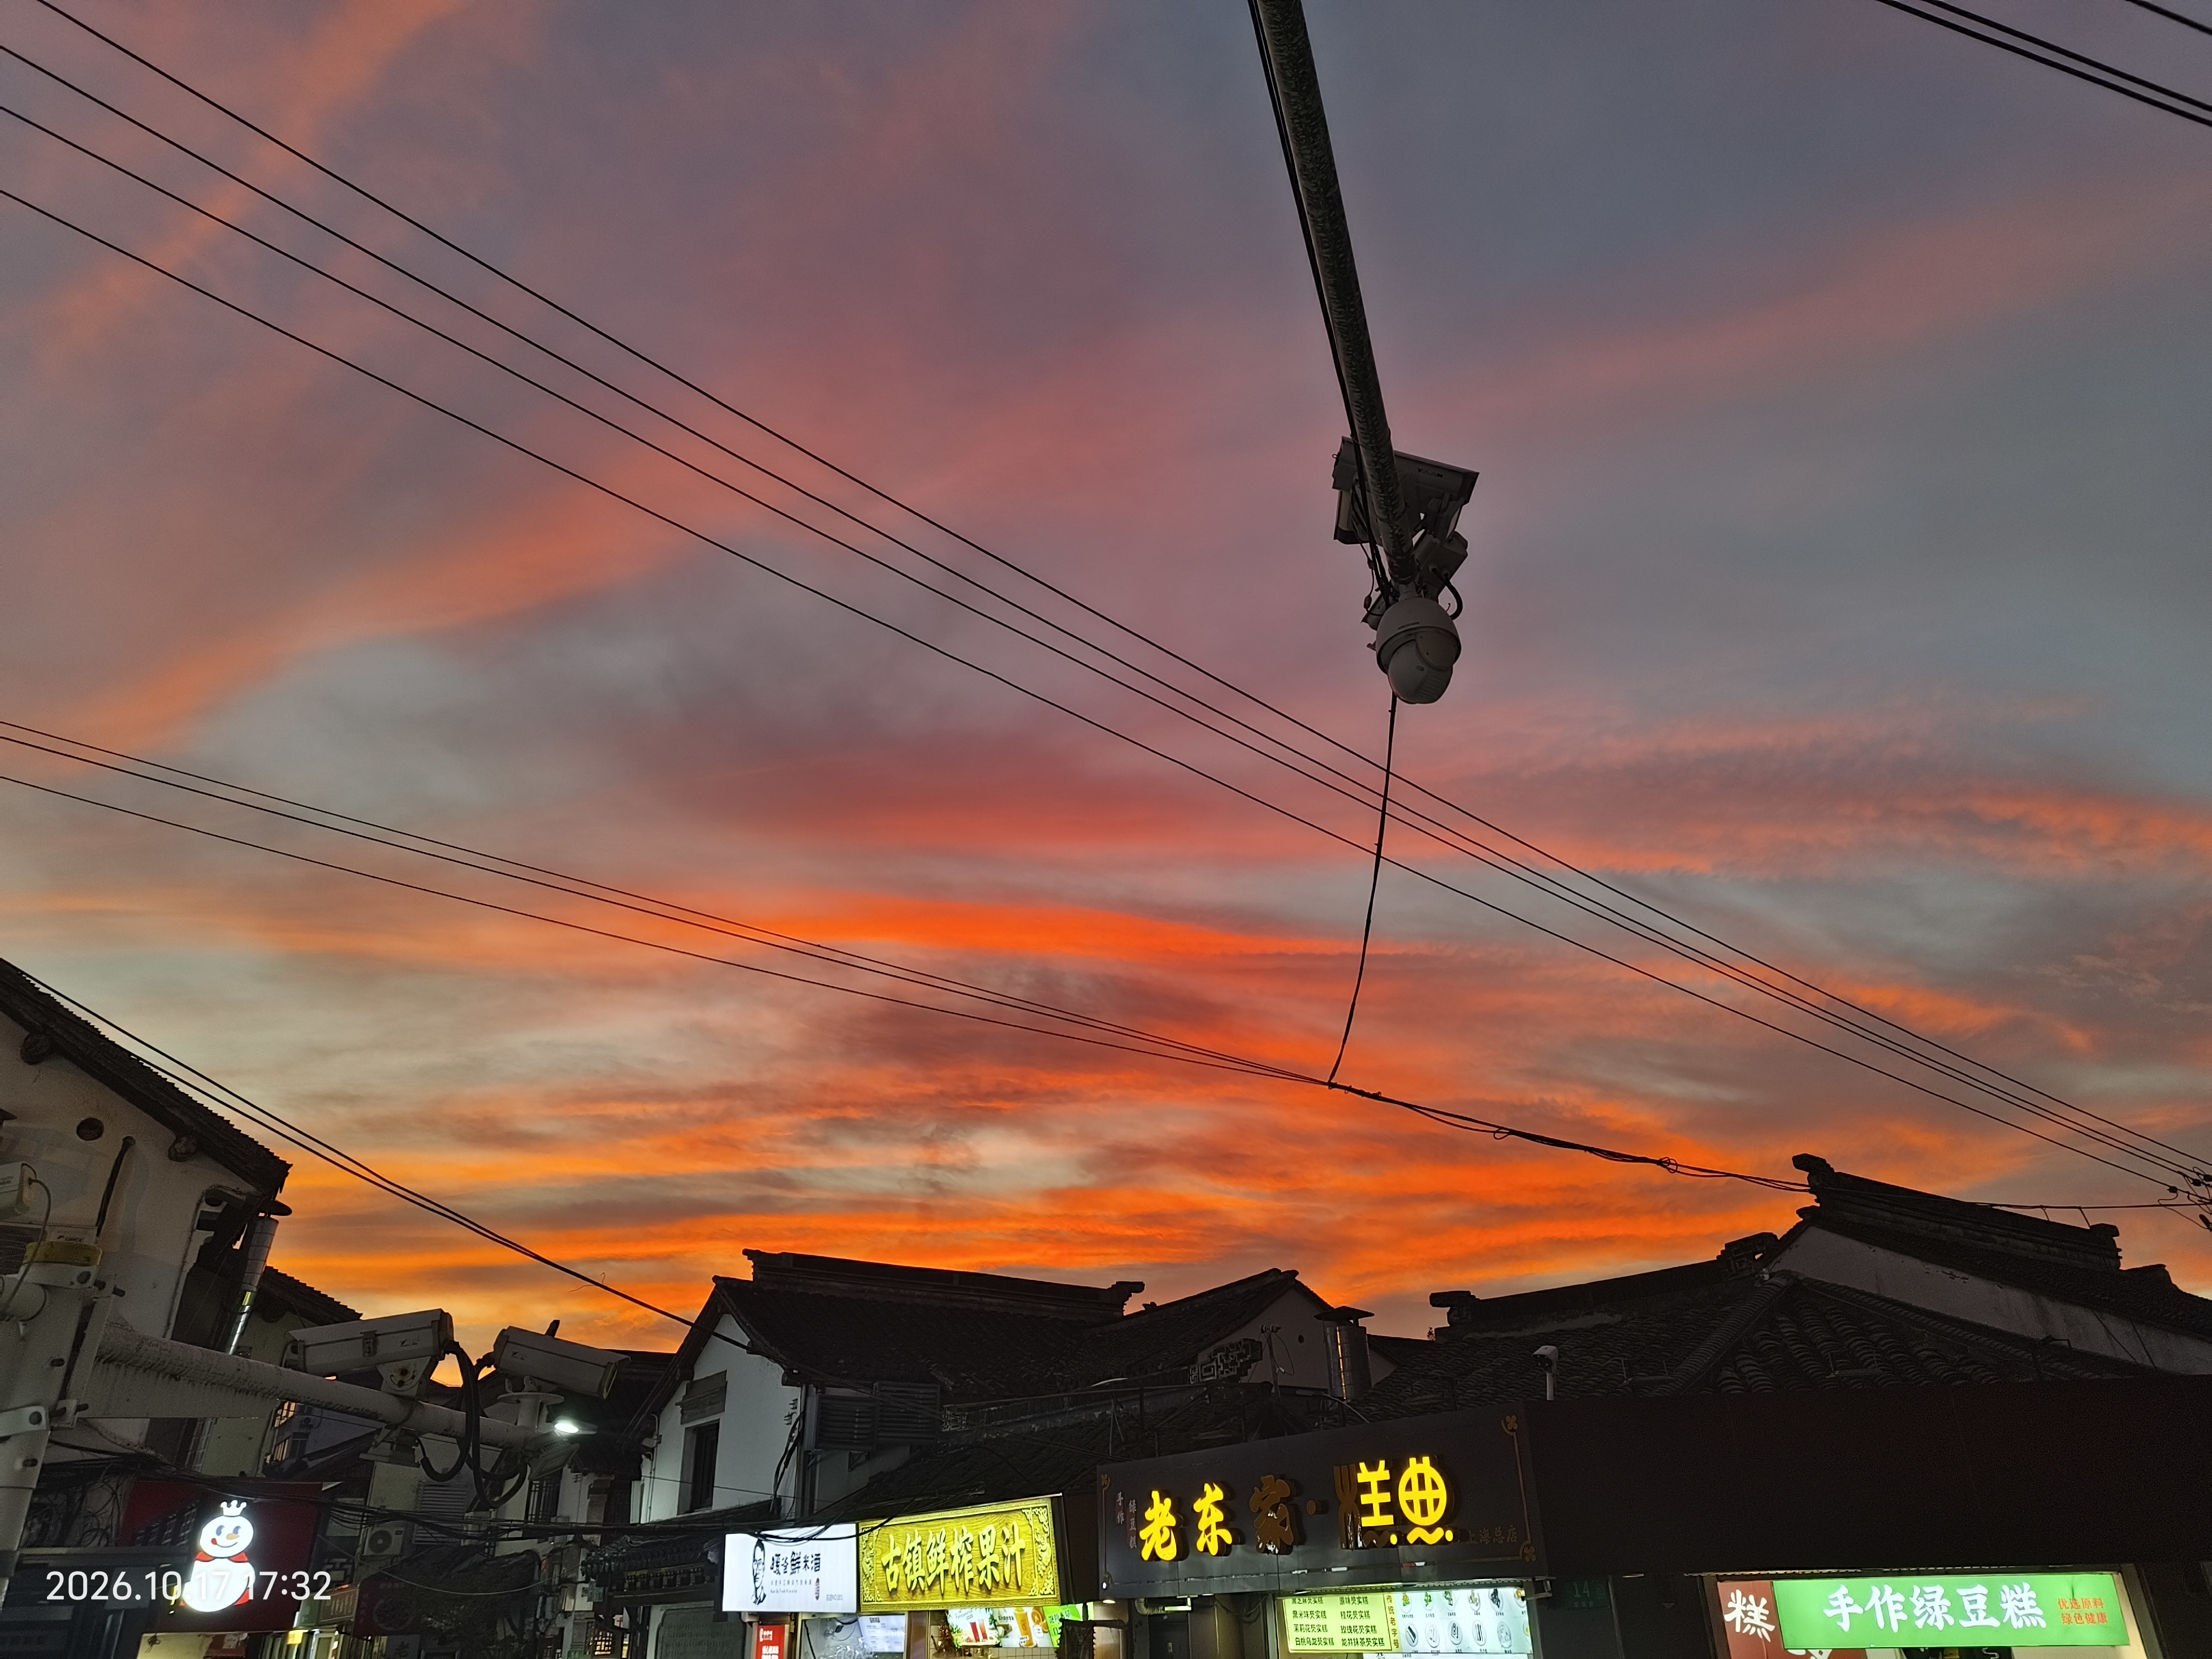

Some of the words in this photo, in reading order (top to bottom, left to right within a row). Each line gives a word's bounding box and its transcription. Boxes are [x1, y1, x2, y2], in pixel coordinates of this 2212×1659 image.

[1116, 1492, 1125, 1525] 手作
[1466, 1524, 1518, 1546] 上海总店
[881, 1521, 1025, 1595] 古镇鲜榨果汁
[1823, 1582, 2046, 1633] 手作绿豆糕
[2058, 1597, 2104, 1610] 优选原料
[1724, 1589, 1775, 1642] 糕
[2061, 1612, 2107, 1625] 绿色健康
[1293, 1624, 1328, 1633] 茉莉花芡实糕
[1340, 1625, 1378, 1634] 玫瑰花芡实糕
[1295, 1637, 1335, 1647] 白桃乌龙芡实糕
[1341, 1637, 1385, 1647] 龙井抹茶芡实糕
